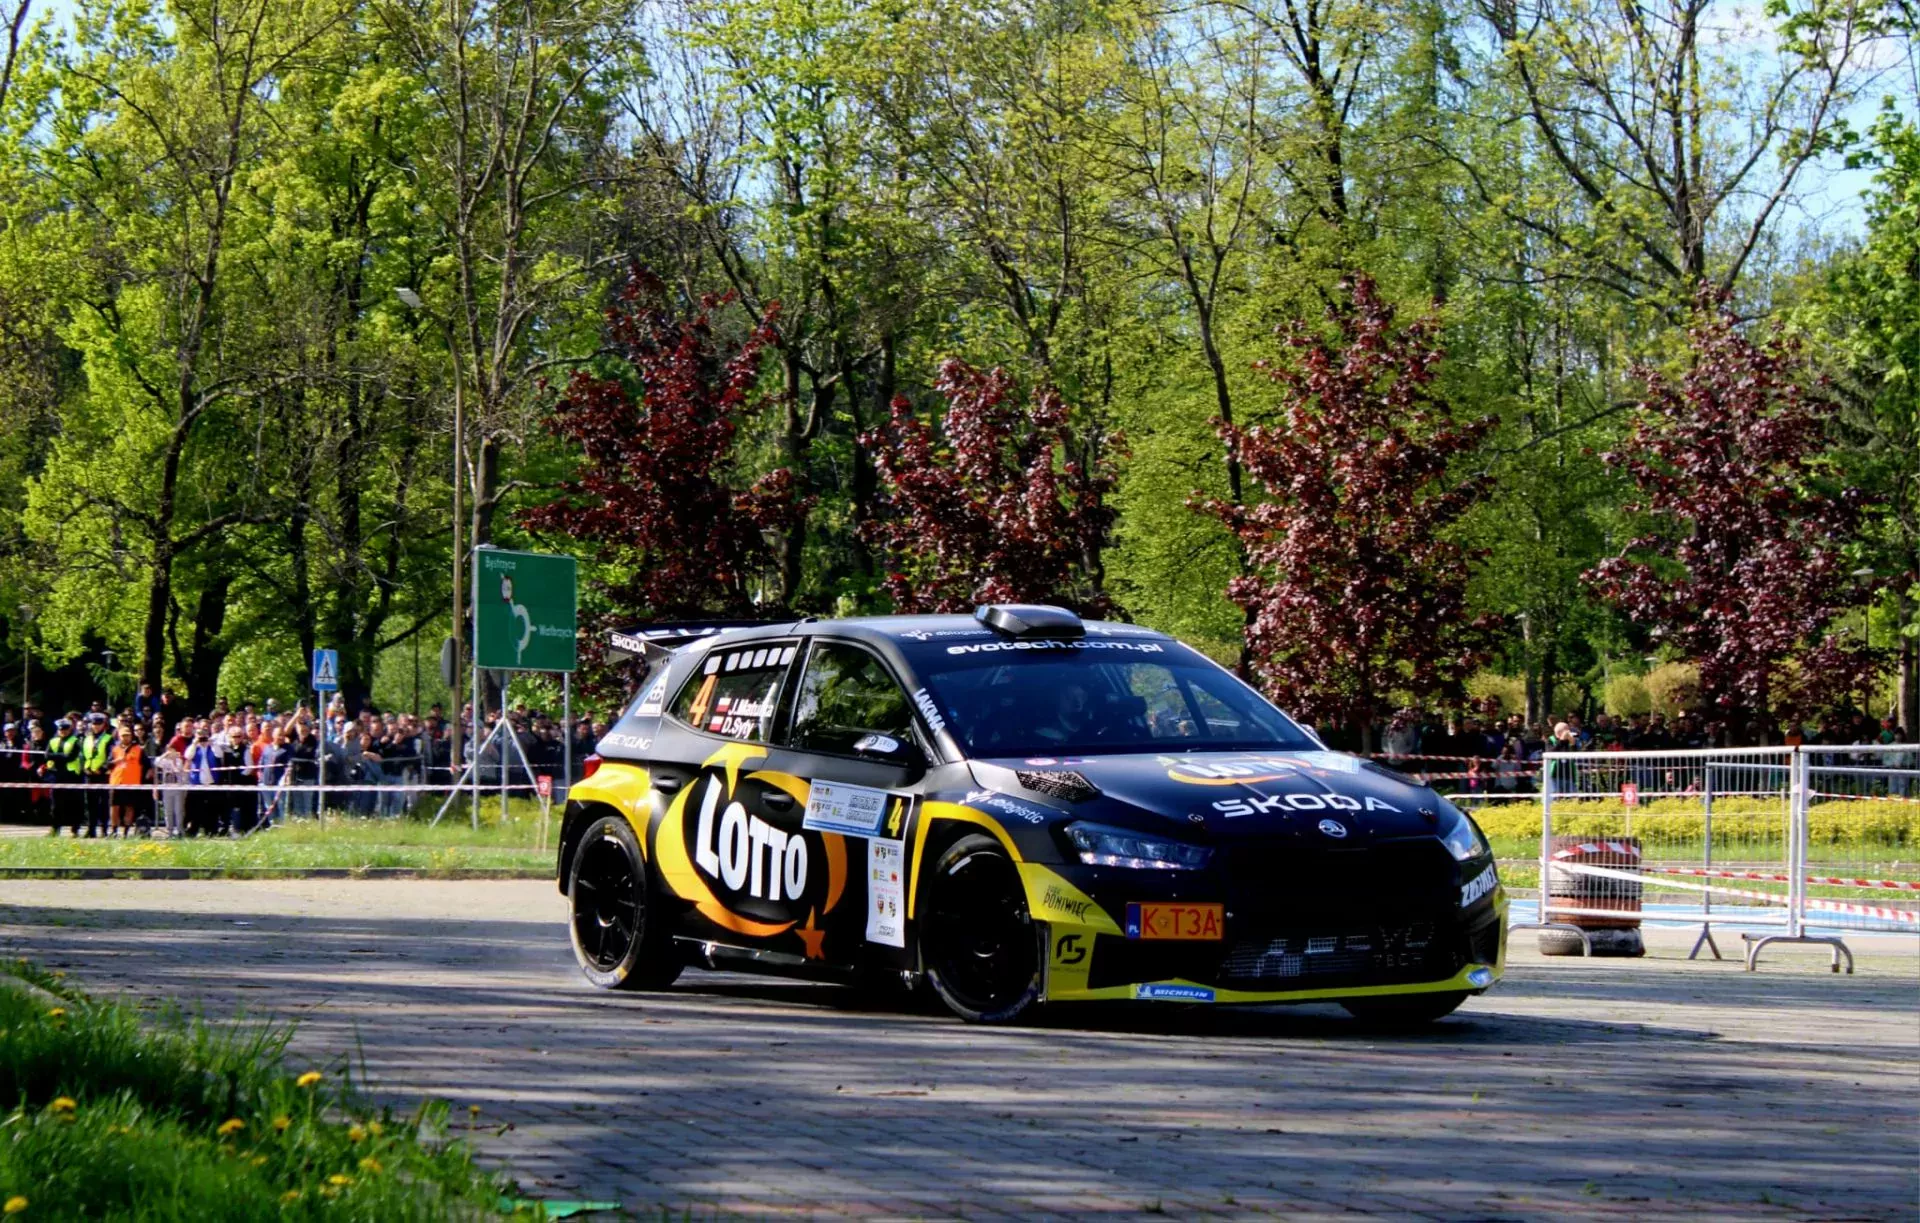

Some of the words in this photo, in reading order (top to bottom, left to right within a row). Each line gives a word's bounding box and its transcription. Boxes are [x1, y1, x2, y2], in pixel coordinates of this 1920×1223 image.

[946, 639, 1164, 655] evotech.com.pl
[689, 674, 718, 726] 4
[913, 688, 946, 737] LAKMA
[887, 797, 904, 838] 4
[695, 773, 808, 901] LOTTO
[1128, 924, 1140, 934] PL
[1143, 908, 1159, 936] K
[1169, 907, 1218, 937] T3A
[1154, 988, 1208, 999] MICHELIN
